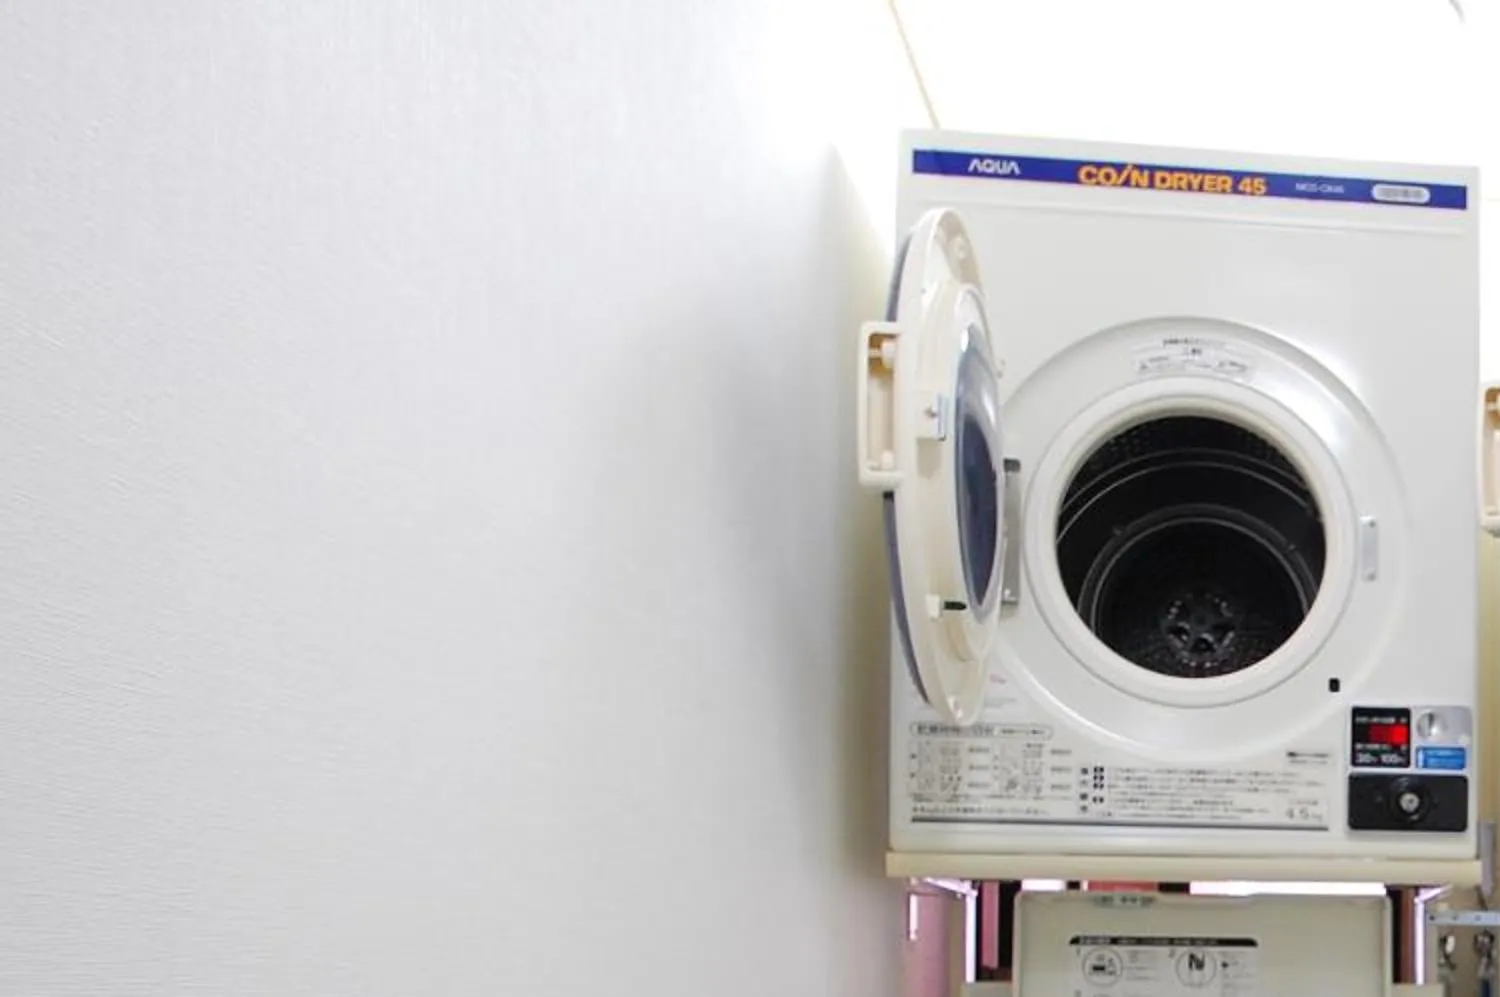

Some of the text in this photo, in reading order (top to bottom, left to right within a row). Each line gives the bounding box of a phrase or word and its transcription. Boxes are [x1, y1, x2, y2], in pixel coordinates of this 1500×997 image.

[968, 158, 1021, 175] AQUA
[1079, 163, 1267, 196] COIN DRYER 45
